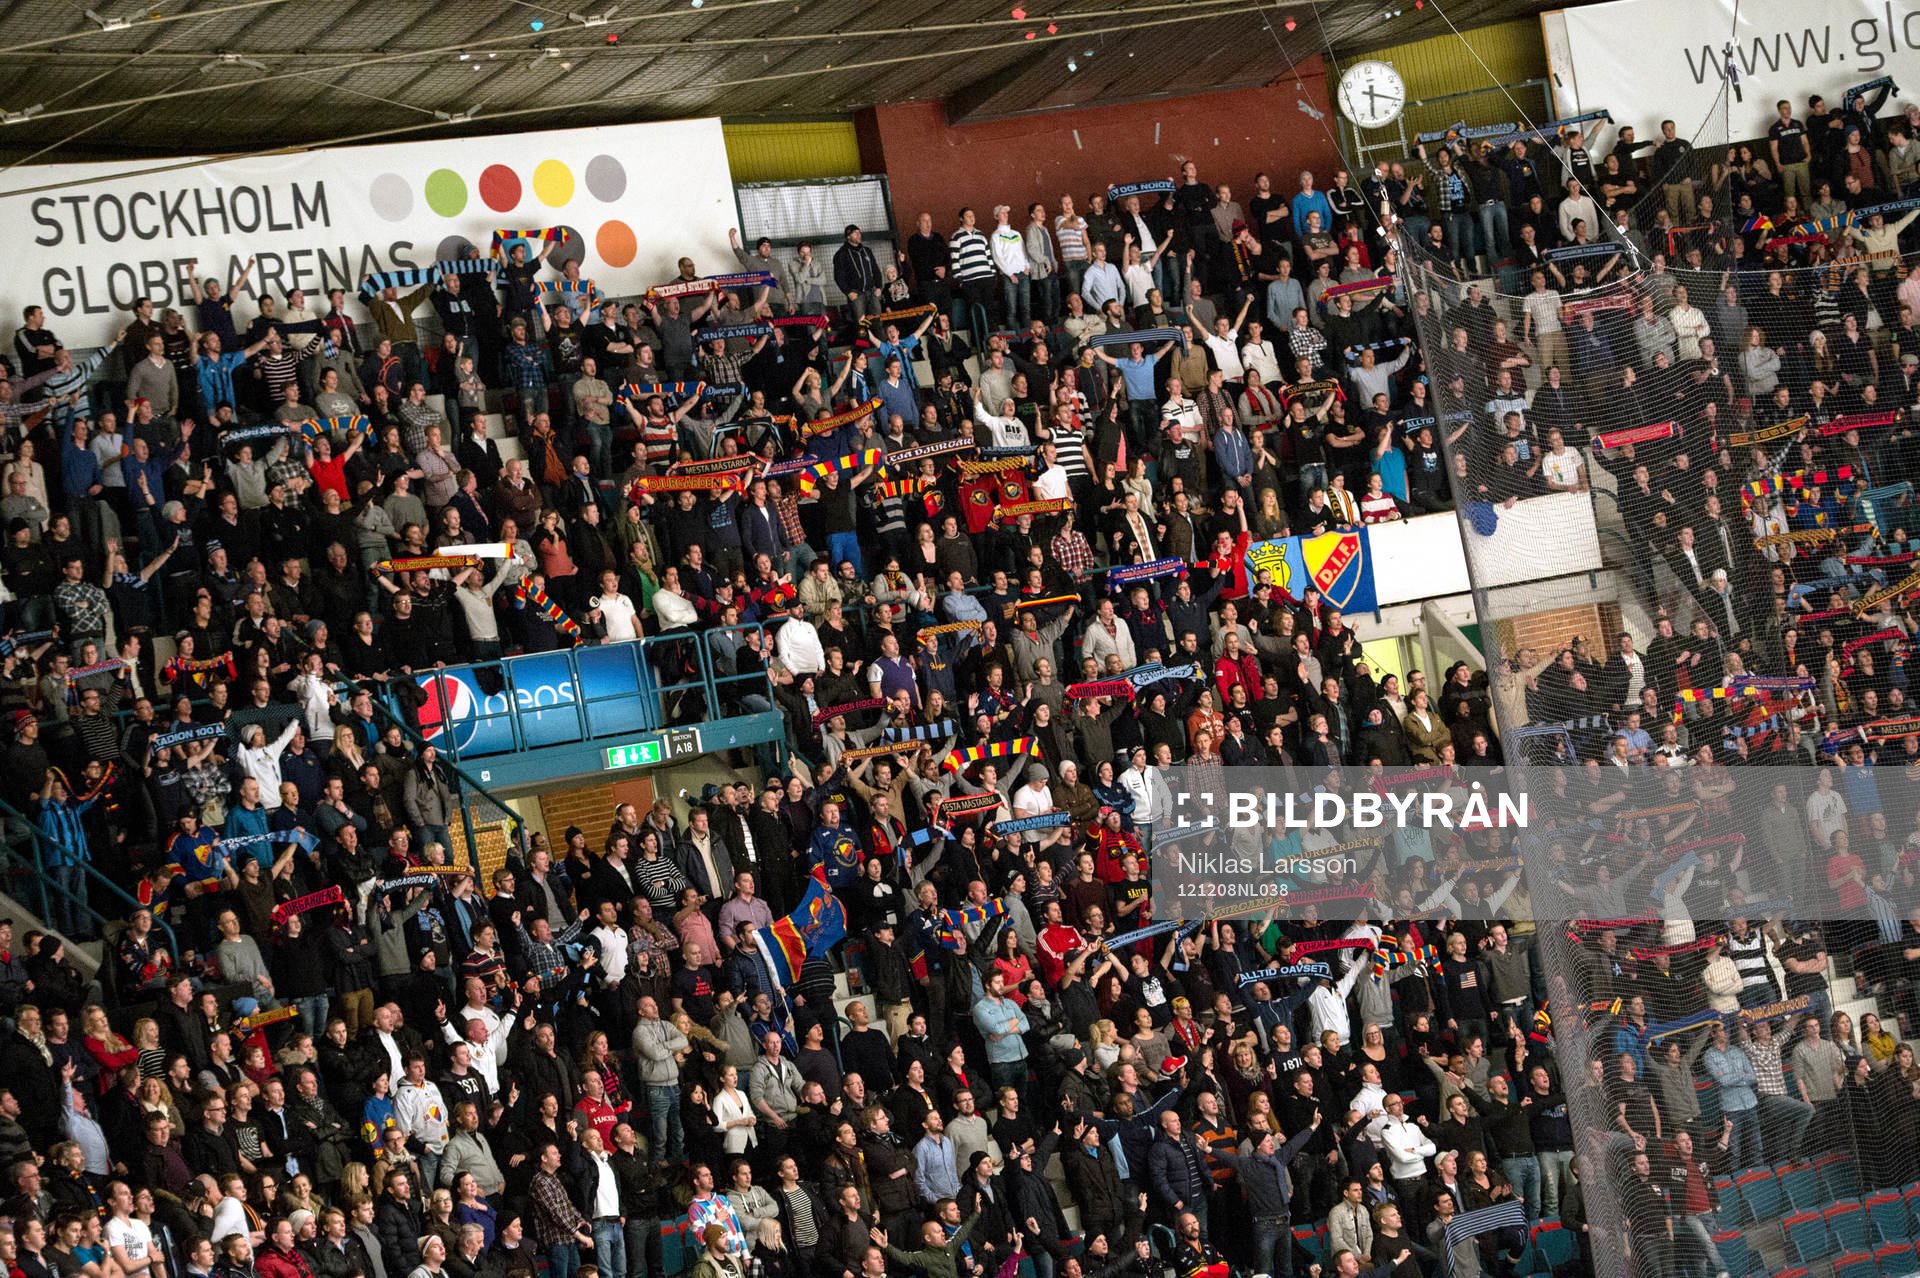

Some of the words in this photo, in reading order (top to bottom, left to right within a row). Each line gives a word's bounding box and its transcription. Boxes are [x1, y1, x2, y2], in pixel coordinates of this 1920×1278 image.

[31, 180, 332, 248] STOCKHOLM
[42, 257, 200, 316] GLOBE
[230, 240, 418, 305] ARENAS
[685, 462, 710, 475] MESTA
[710, 458, 751, 473] MÄSTARNA
[1318, 543, 1356, 585] D.I.F.
[1240, 967, 1277, 983] ALLTID
